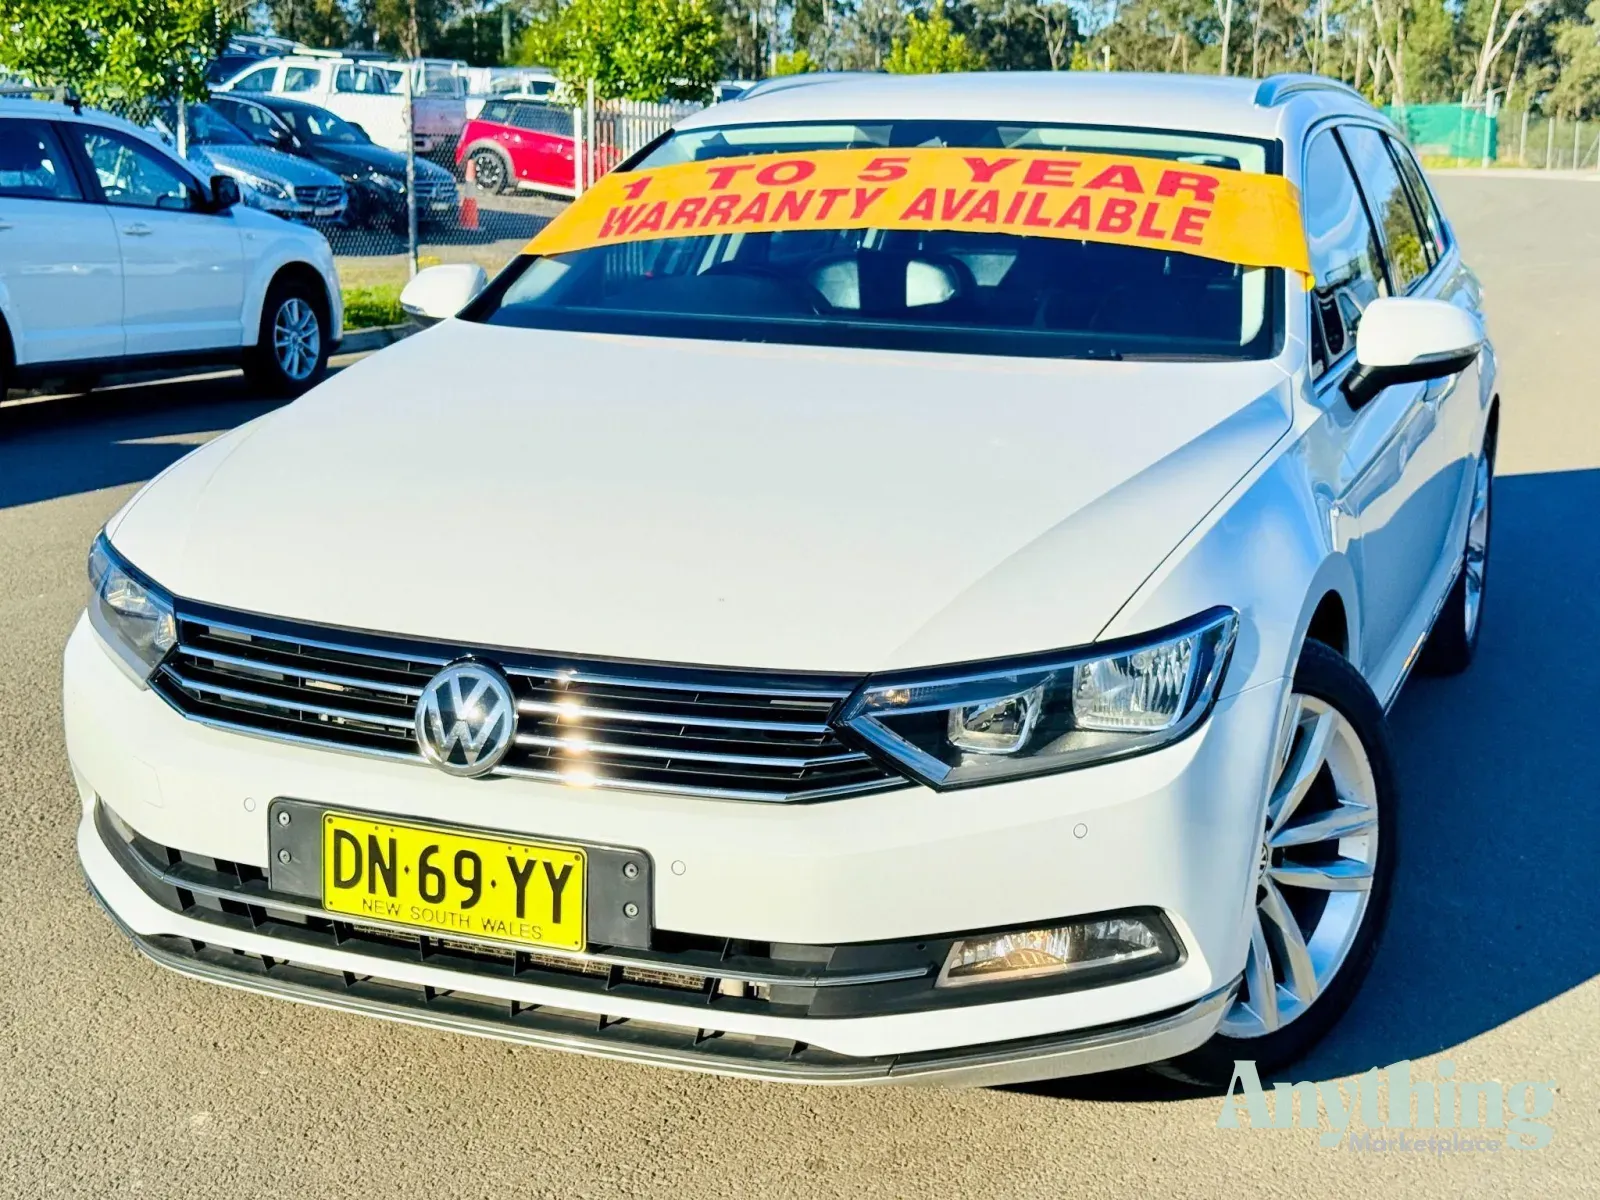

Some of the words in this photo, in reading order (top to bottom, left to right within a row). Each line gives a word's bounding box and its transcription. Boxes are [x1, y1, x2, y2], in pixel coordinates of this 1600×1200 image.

[622, 177, 652, 200] 1
[708, 156, 815, 191] TO
[859, 158, 909, 182] 5
[963, 157, 1220, 203] YEAR
[598, 187, 887, 238] WARRANTY
[901, 187, 1212, 245] AVAILABLE
[362, 897, 402, 917] NEW
[410, 905, 471, 930] SOUTH
[482, 919, 544, 941] WALES
